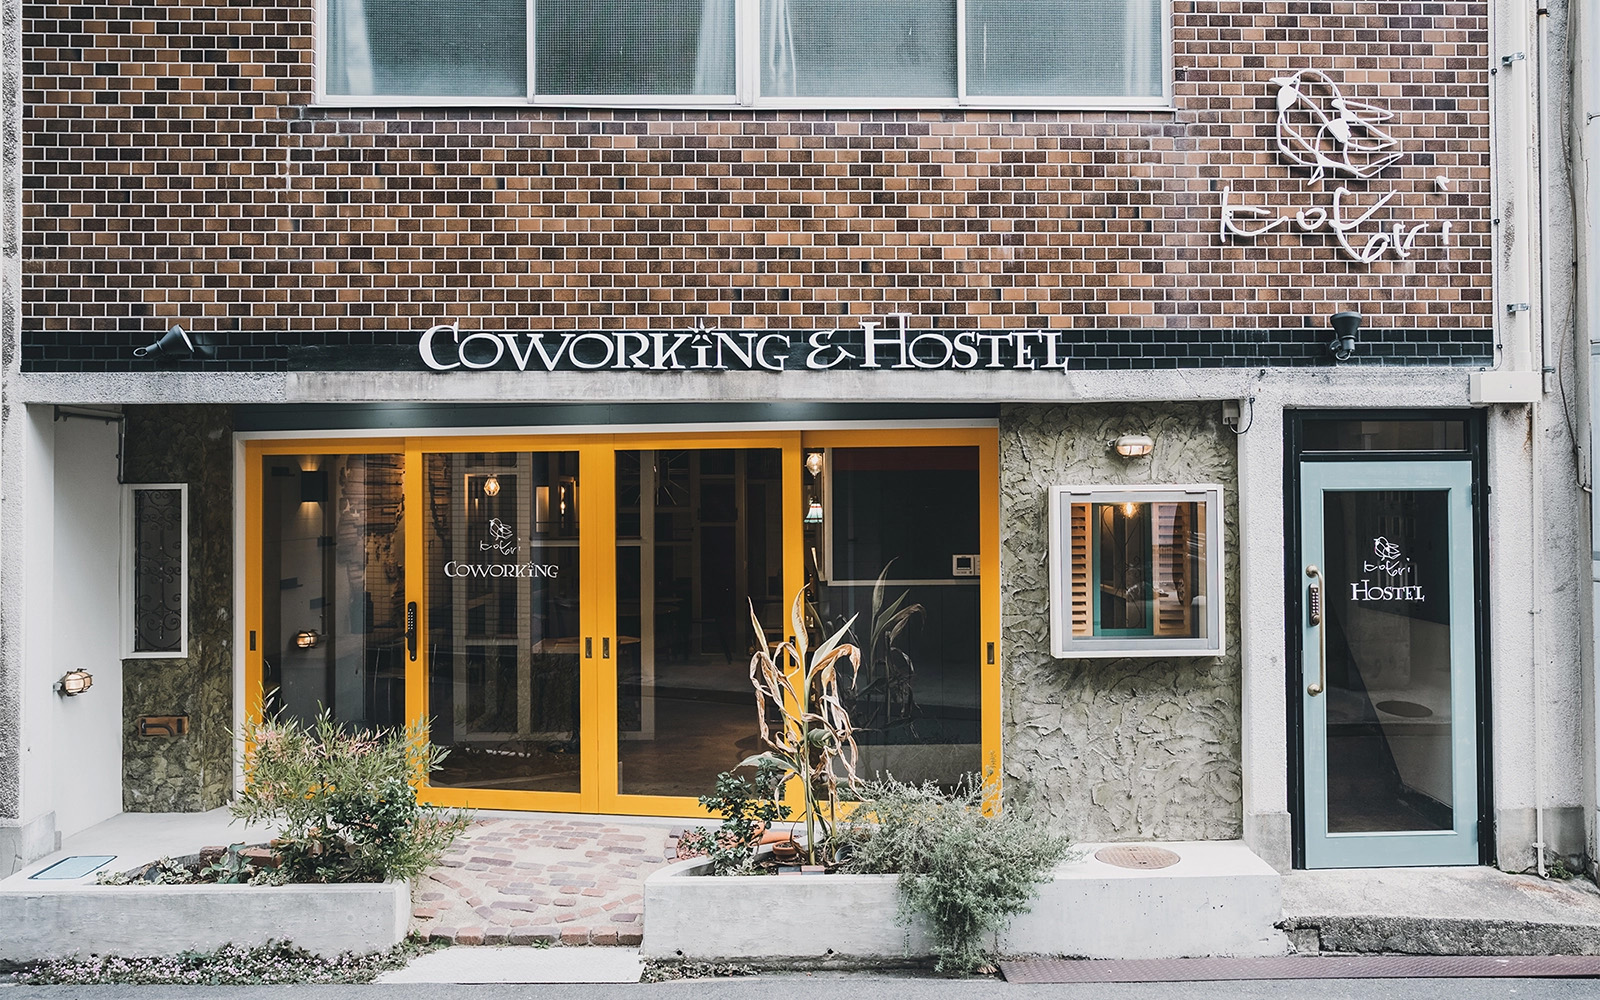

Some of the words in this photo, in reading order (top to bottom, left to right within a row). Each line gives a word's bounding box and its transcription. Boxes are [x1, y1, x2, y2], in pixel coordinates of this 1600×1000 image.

[806, 329, 856, 369] &
[858, 312, 1069, 374] HOSTEL
[1350, 579, 1425, 602] HOSTEL
